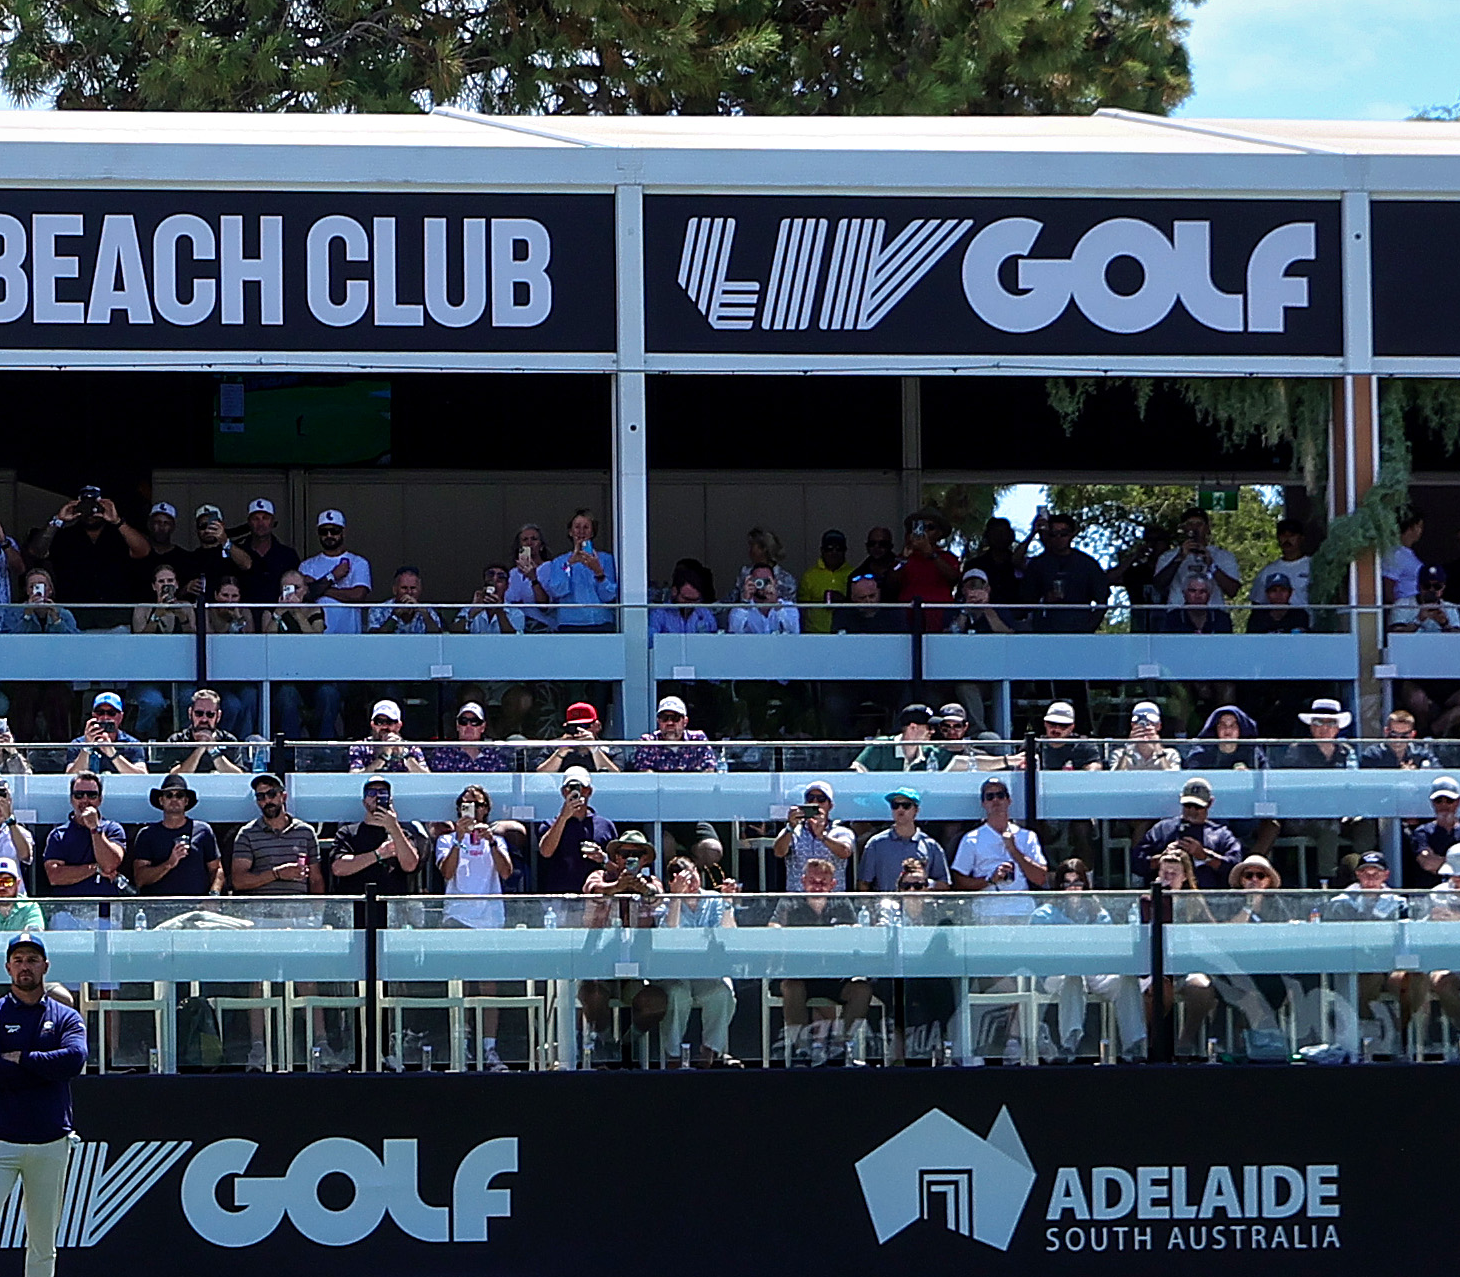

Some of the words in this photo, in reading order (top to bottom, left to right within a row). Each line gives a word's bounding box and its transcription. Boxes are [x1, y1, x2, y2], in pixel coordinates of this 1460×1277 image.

[306, 214, 552, 328] CLUB
[677, 217, 974, 330] LIV
[962, 217, 1316, 333] GOLF
[181, 1136, 519, 1248] GOLF
[1045, 1164, 1341, 1220] ADELAIDE
[1046, 1225, 1152, 1252] SOUTH
[1167, 1224, 1341, 1251] AUSTRALIA
